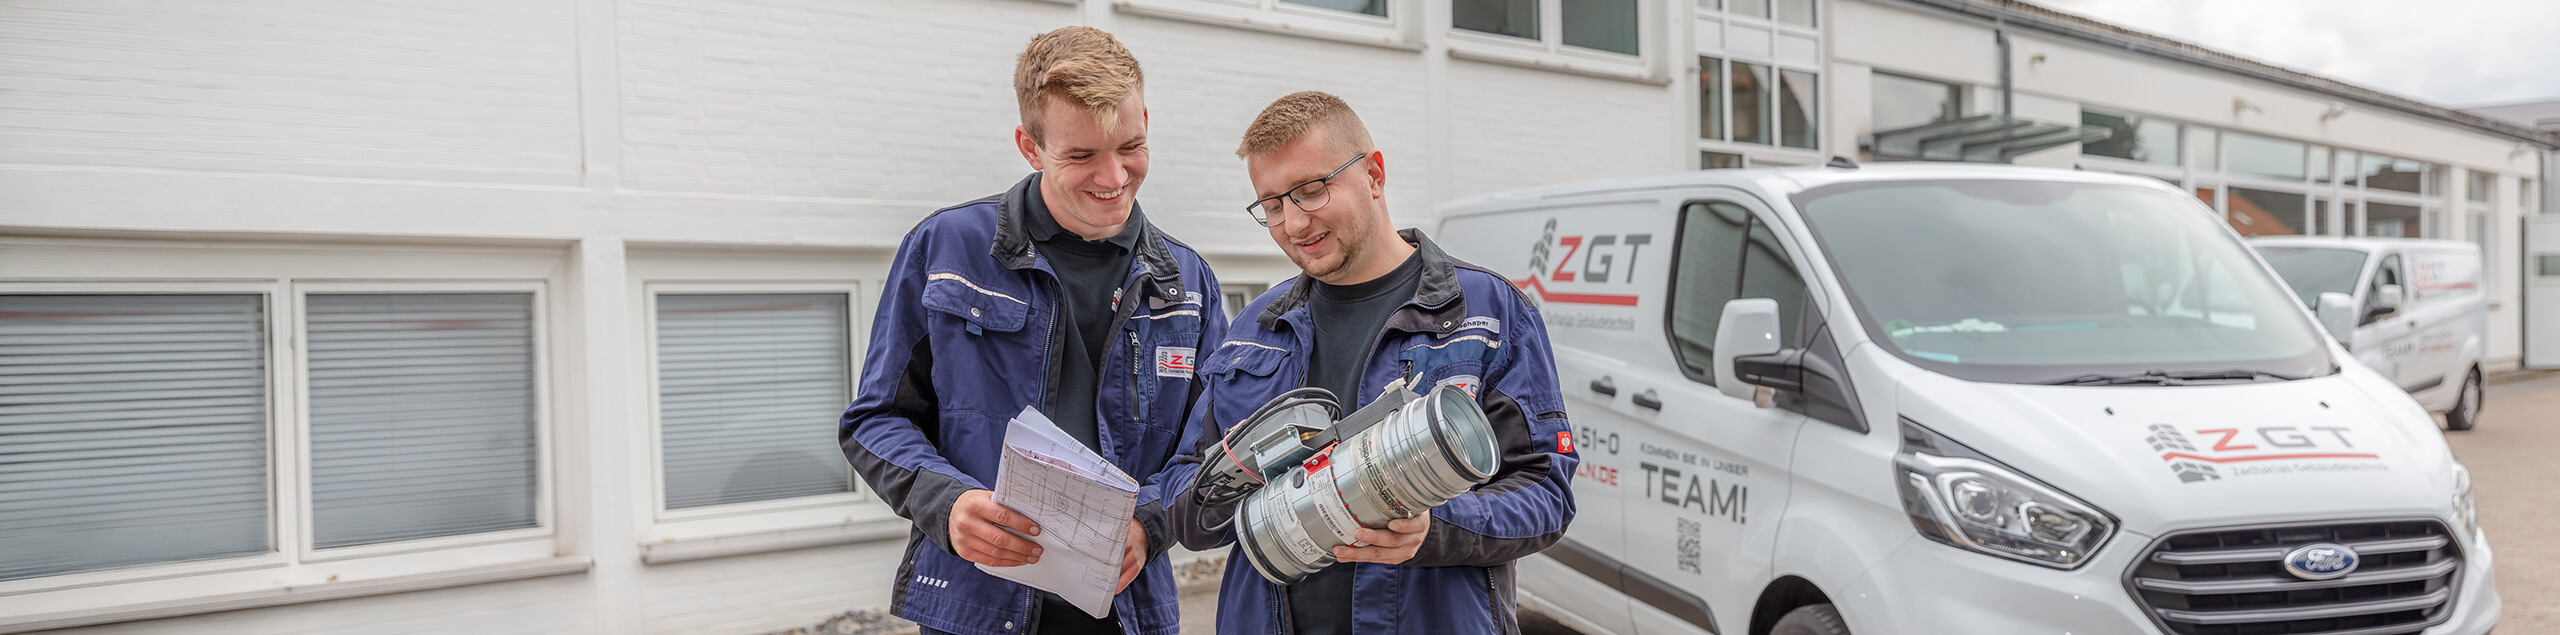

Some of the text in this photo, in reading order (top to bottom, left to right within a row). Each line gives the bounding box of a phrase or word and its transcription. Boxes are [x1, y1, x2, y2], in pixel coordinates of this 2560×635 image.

[1551, 234, 1652, 284] ZGT
[1170, 354, 1194, 367] ZG
[2196, 427, 2354, 452] ZGT
[1640, 443, 1749, 477] KOMMEN SIE IN UNSER
[2231, 464, 2293, 477] Zacharias
[1640, 462, 1747, 524] TEAM!
[2305, 549, 2346, 571] Ford
